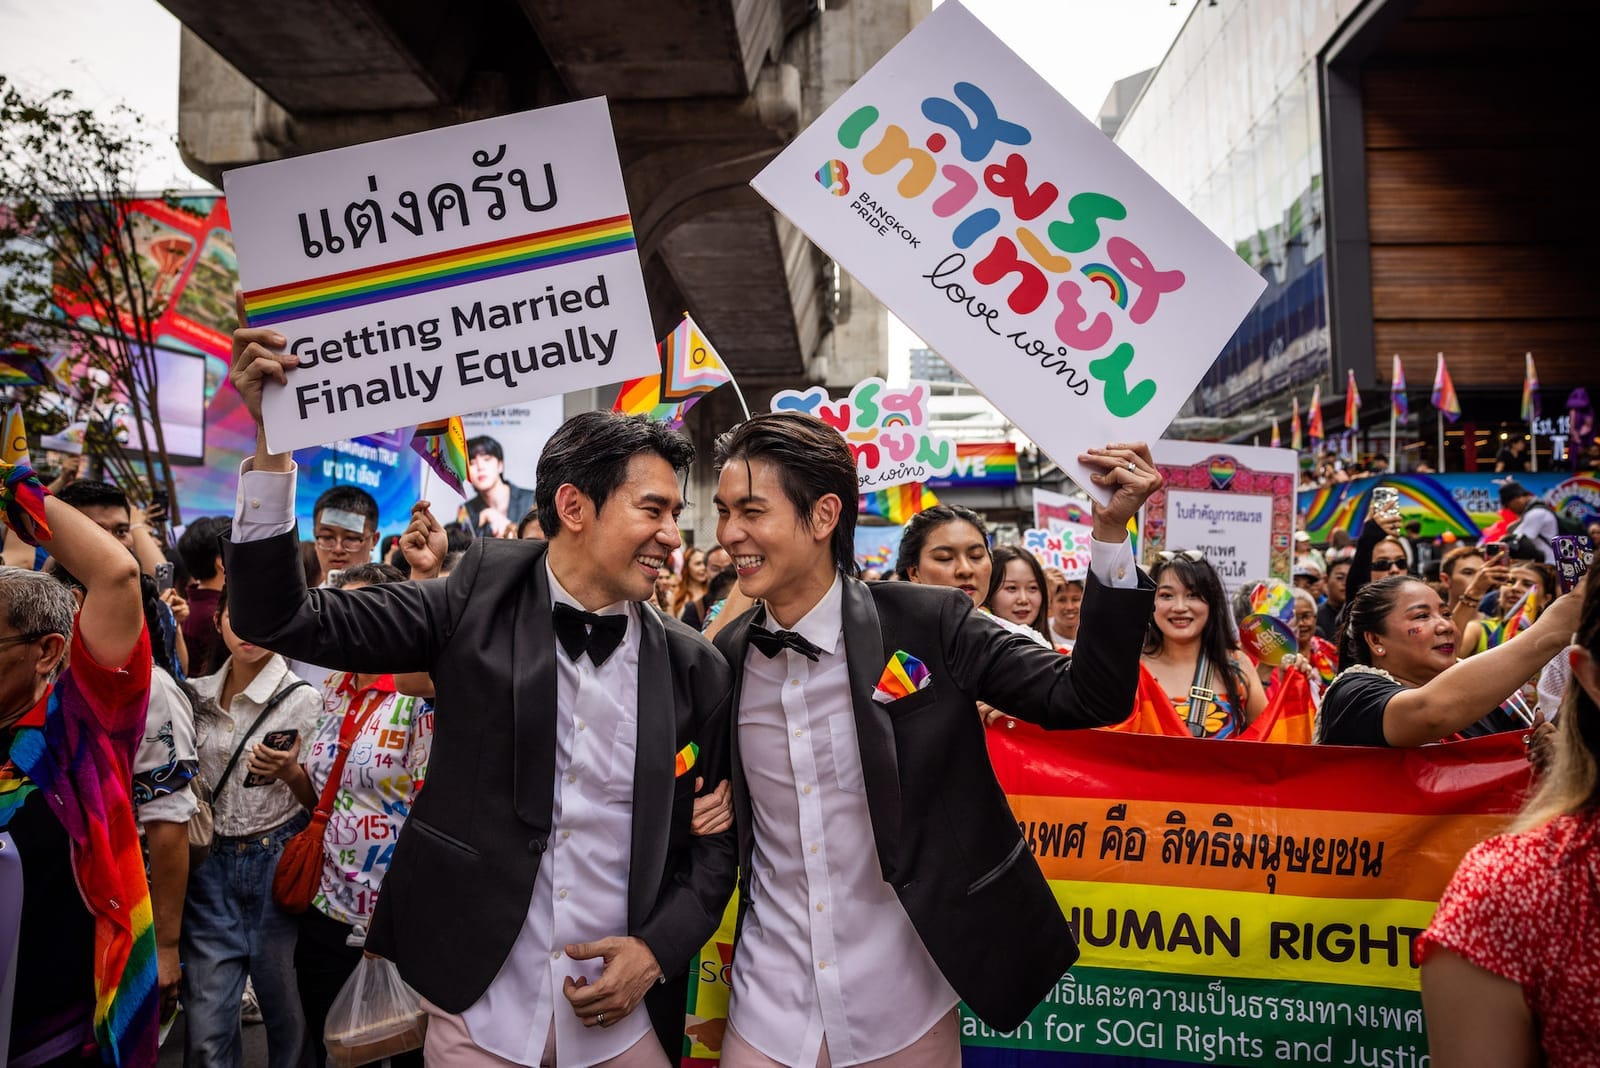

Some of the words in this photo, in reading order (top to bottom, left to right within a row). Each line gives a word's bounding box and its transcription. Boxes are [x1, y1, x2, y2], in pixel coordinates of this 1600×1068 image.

[297, 144, 558, 258] แต่งครับ
[850, 201, 889, 237] PRIDE
[858, 192, 921, 249] BANGKOK
[289, 319, 441, 372] Getting
[451, 275, 610, 337] Married
[922, 253, 1001, 336] love
[1006, 331, 1089, 396] wins
[296, 361, 443, 420] Finally
[456, 326, 618, 388] Equally
[374, 754, 393, 768] 14
[378, 729, 406, 750] 15
[356, 815, 390, 840] 15
[1099, 803, 1147, 862] คือ
[1161, 811, 1385, 894] สิทธิมนุษยชน
[1269, 921, 1426, 969] RIGHT
[1045, 1013, 1085, 1043] for
[1096, 1018, 1164, 1050] SOGI
[1176, 1024, 1264, 1062] Rights
[1275, 1036, 1333, 1063] and
